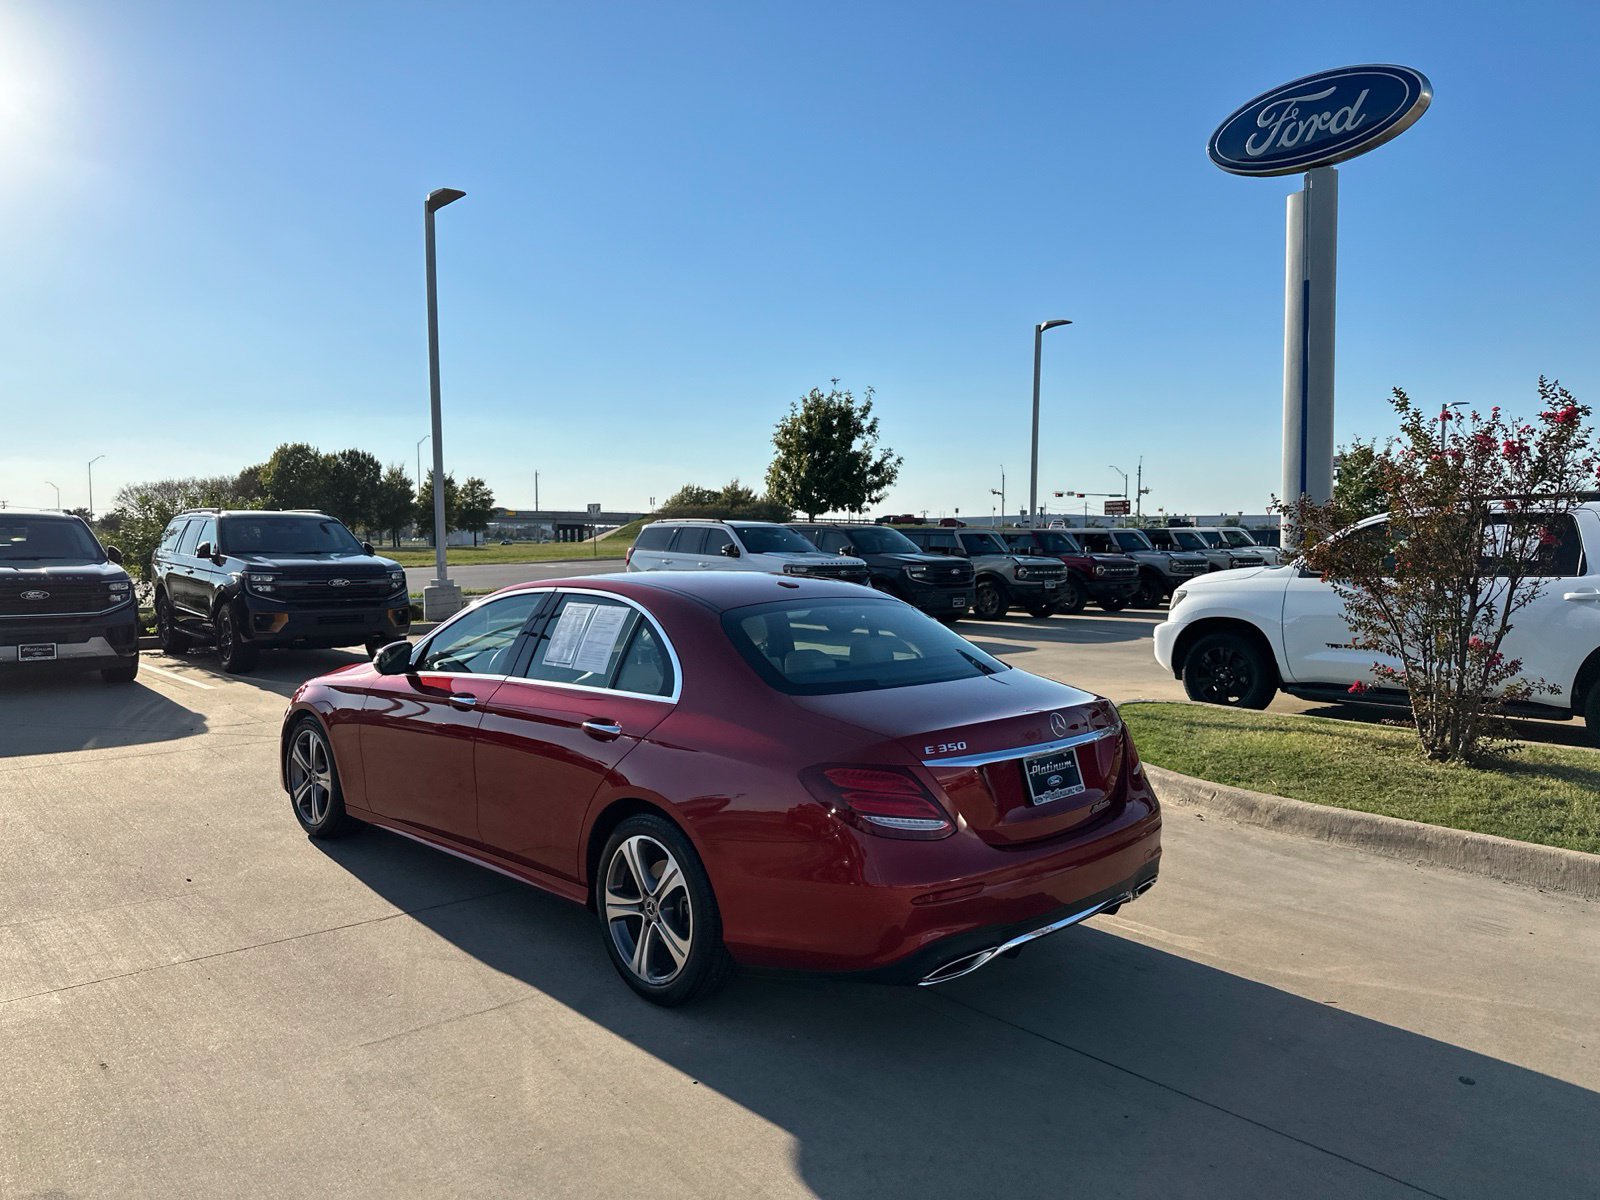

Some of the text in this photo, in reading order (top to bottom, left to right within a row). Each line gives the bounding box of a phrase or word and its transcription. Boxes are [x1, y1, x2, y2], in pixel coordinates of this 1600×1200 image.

[1245, 86, 1370, 157] Ford
[925, 741, 967, 754] E 350
[1029, 760, 1076, 776] Platinum
